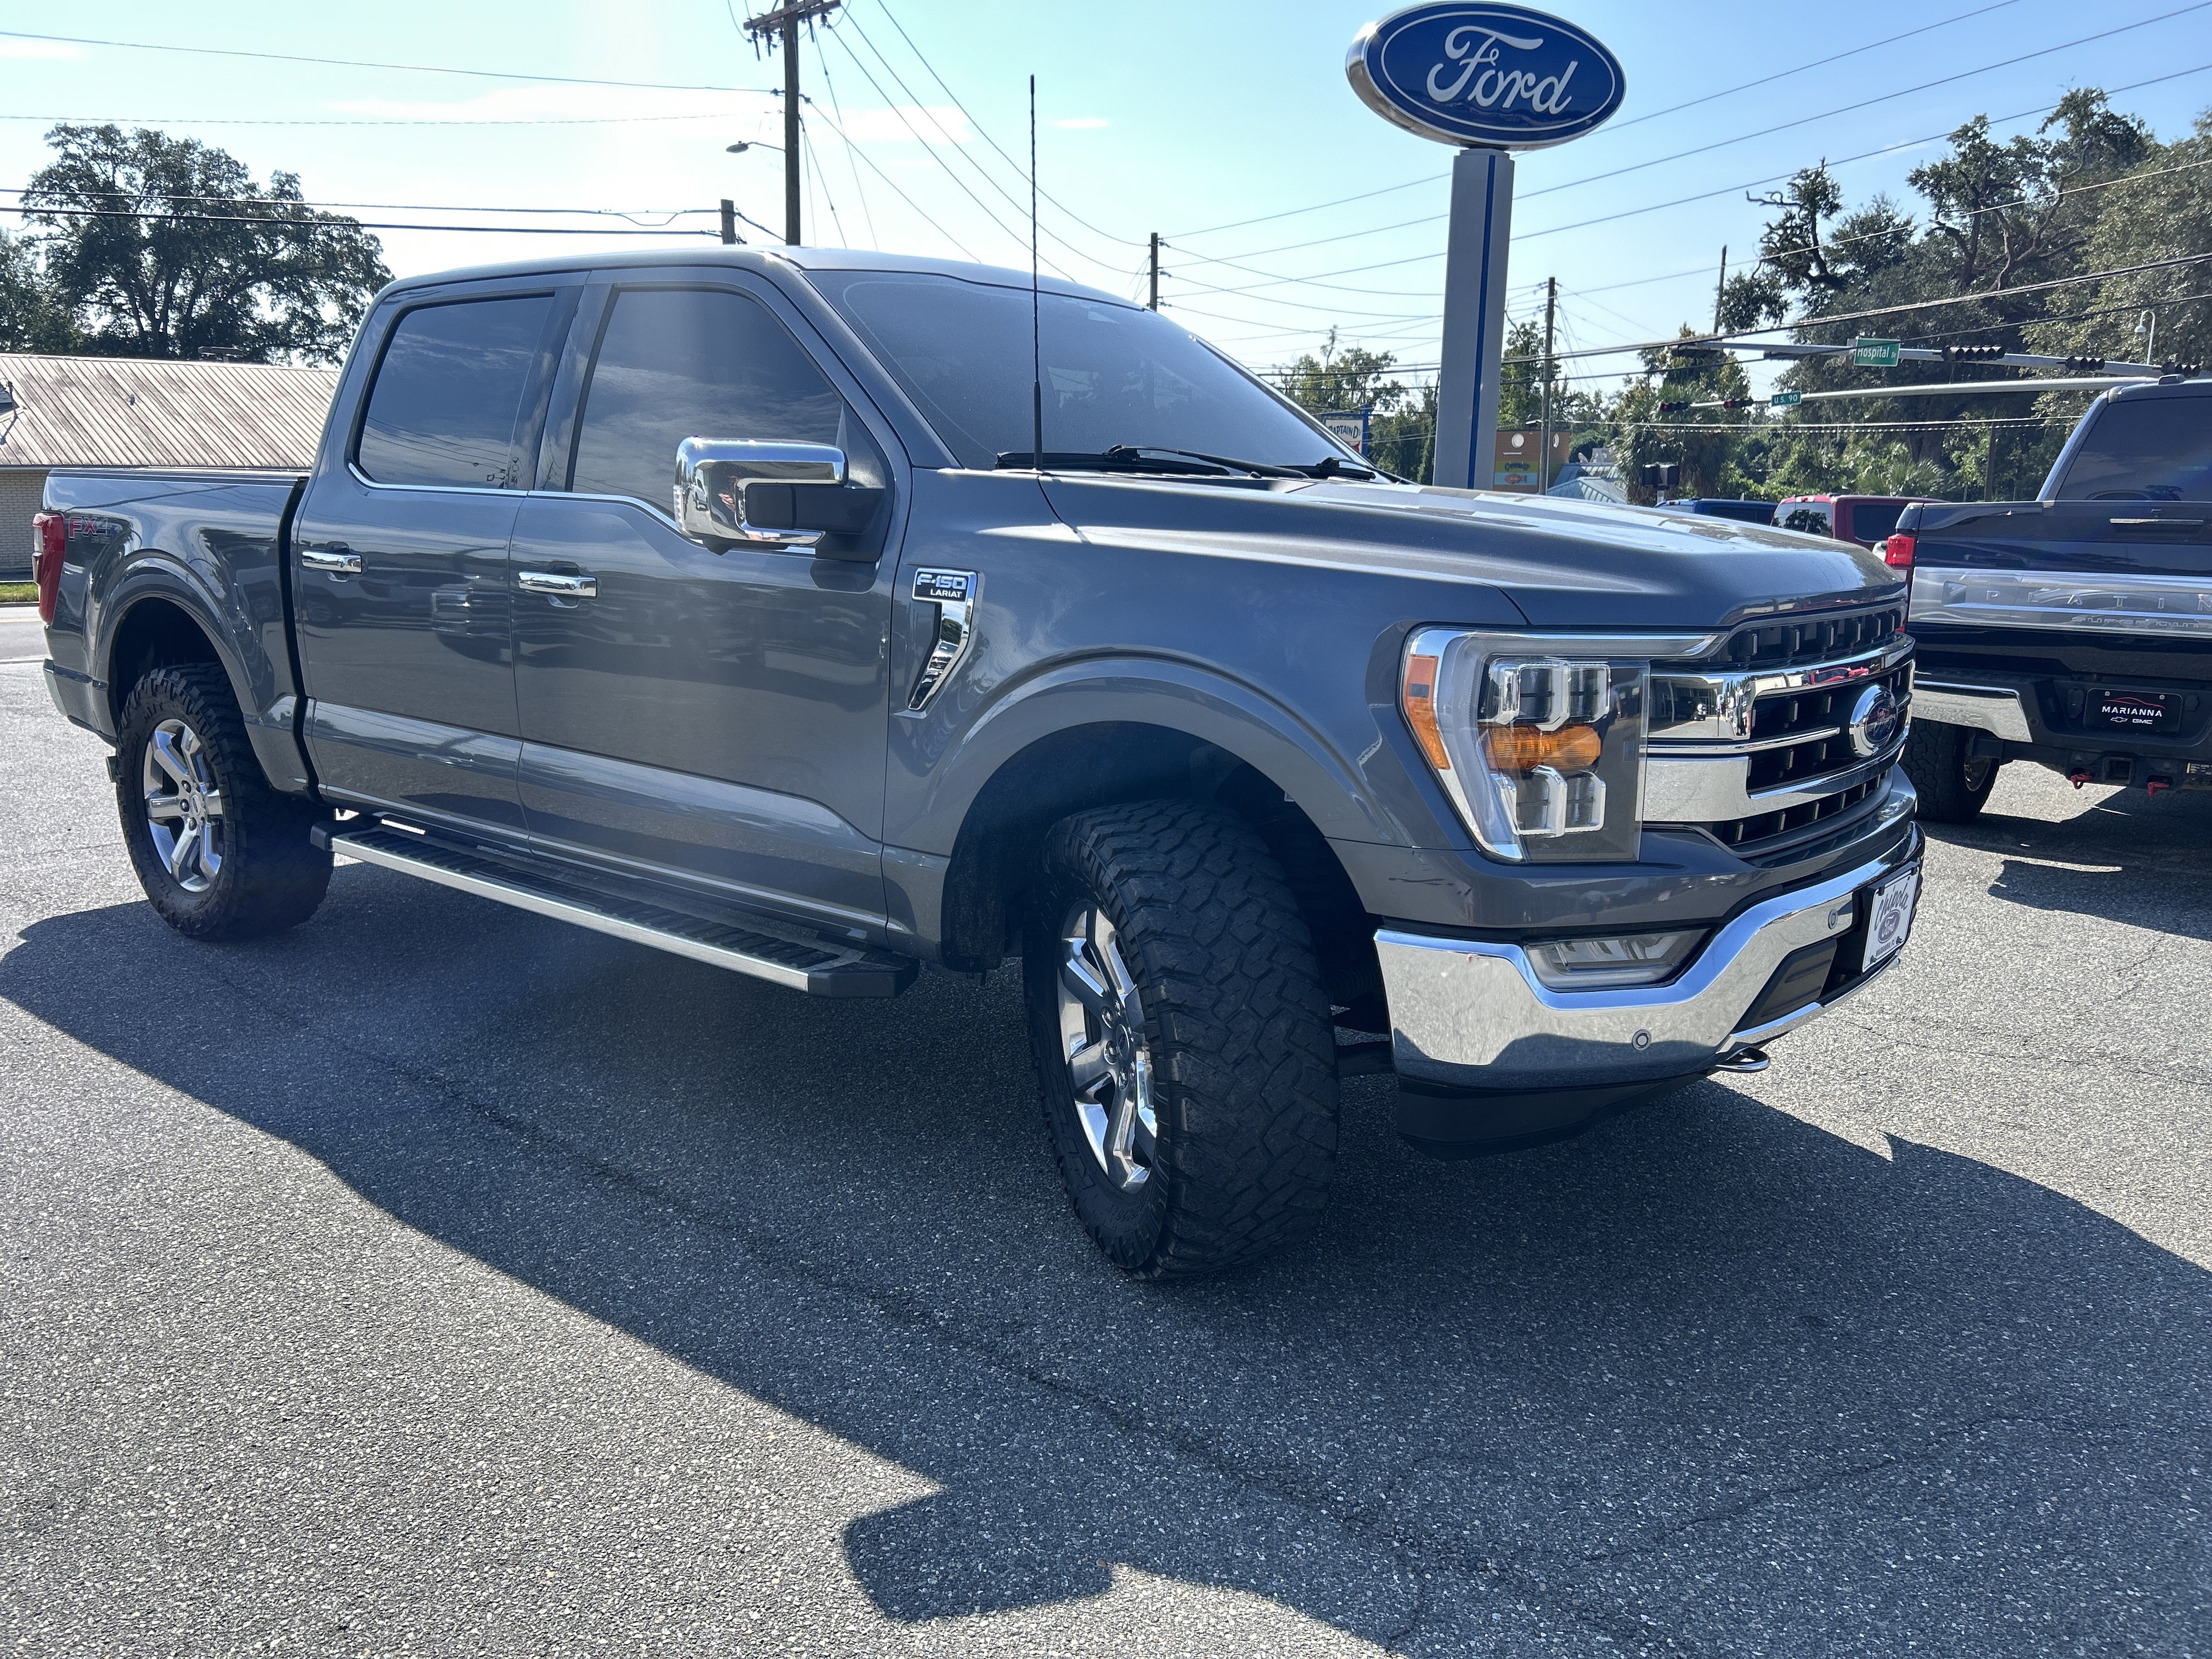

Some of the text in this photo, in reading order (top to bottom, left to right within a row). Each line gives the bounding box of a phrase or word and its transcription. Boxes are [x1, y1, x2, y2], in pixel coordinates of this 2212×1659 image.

[1426, 25, 1578, 114] Ford
[1857, 346, 1889, 360] Hospital
[1774, 394, 1798, 404] U.S. 90
[69, 515, 111, 541] FX4
[916, 574, 967, 590] F-150
[930, 588, 963, 599] LARIAT
[2101, 706, 2162, 717] MARIANNA
[1874, 882, 1909, 931] Chipola
[1881, 915, 1897, 938] Ford
